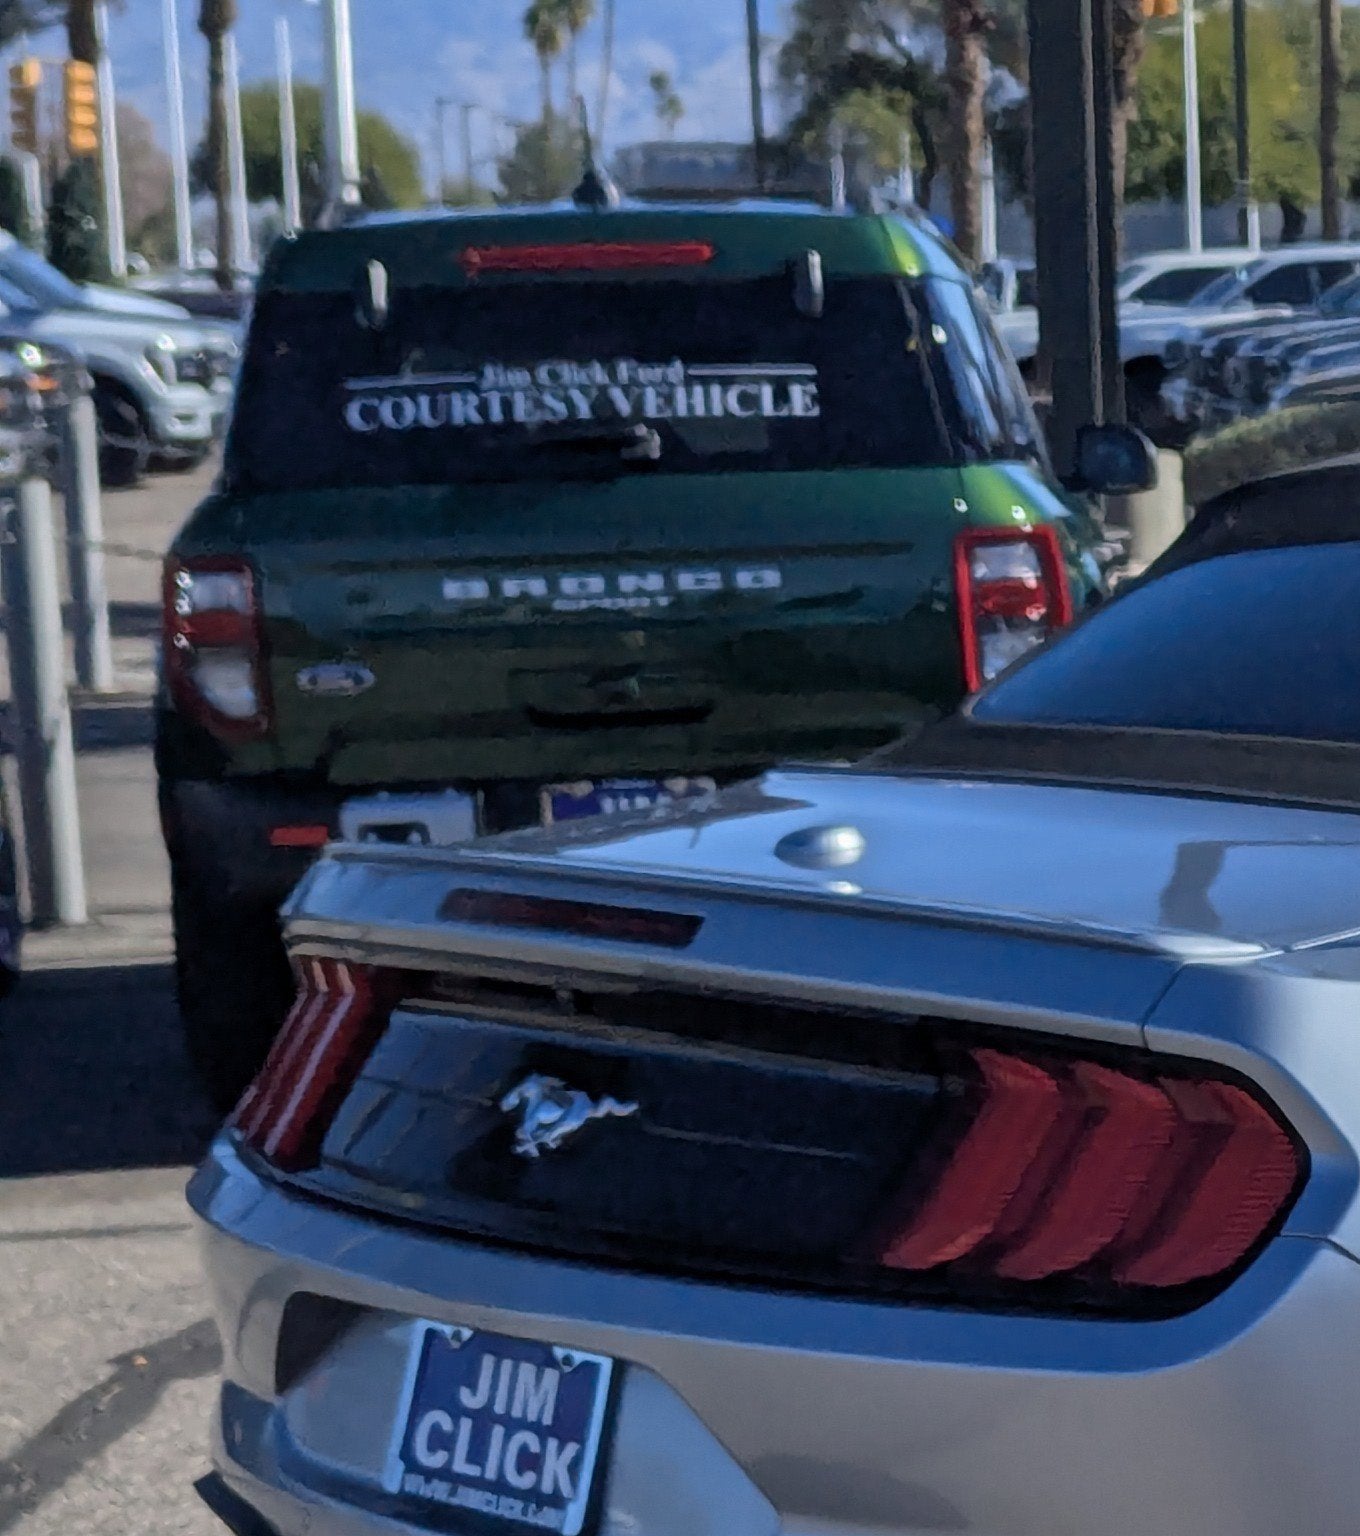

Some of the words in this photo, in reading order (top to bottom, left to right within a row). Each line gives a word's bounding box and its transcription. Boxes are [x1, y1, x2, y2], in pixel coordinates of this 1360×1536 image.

[344, 388, 600, 432] COURTESY
[607, 382, 821, 419] VEHICLE
[458, 1352, 561, 1427] JIM
[413, 1408, 582, 1500] CLICK
